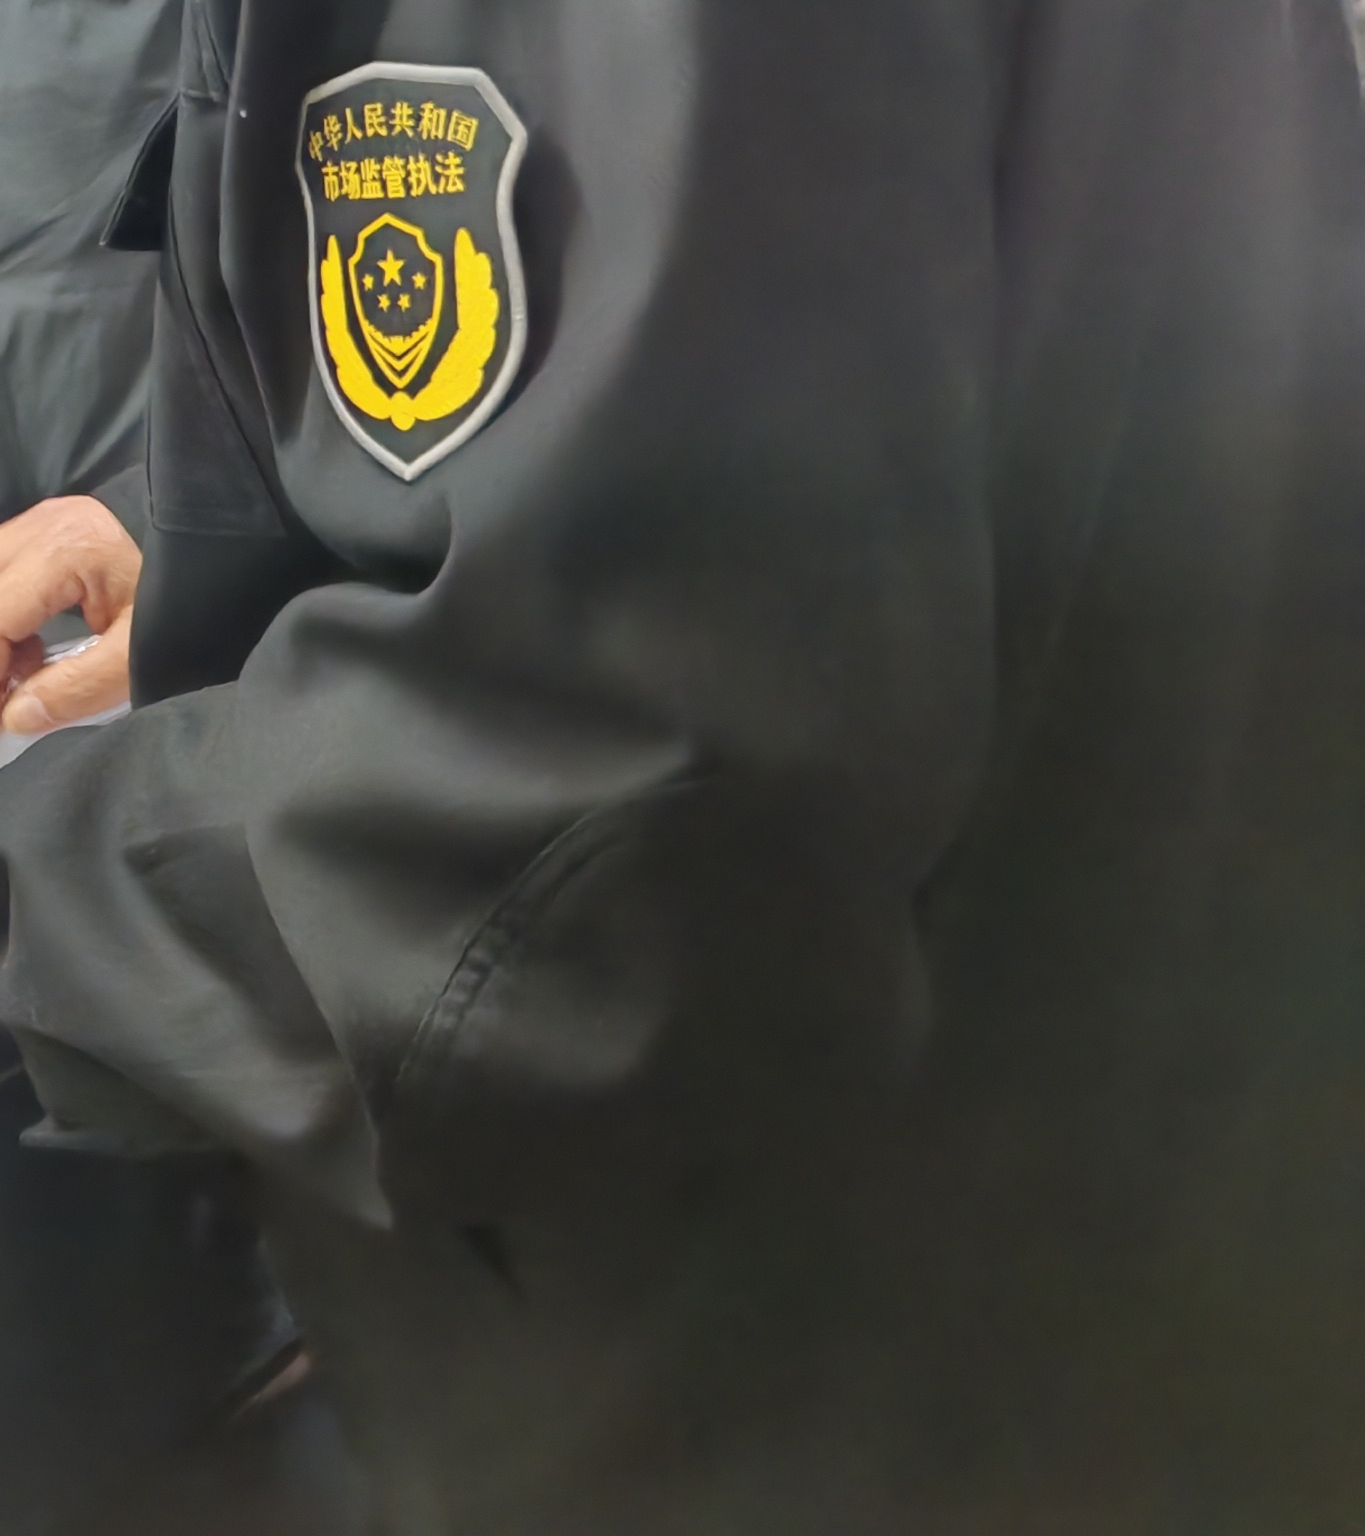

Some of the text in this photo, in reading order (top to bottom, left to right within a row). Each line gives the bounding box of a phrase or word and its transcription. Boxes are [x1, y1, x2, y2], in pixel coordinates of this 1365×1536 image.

[307, 101, 479, 162] 中华人民共和国
[320, 150, 466, 203] 市场监管执法
